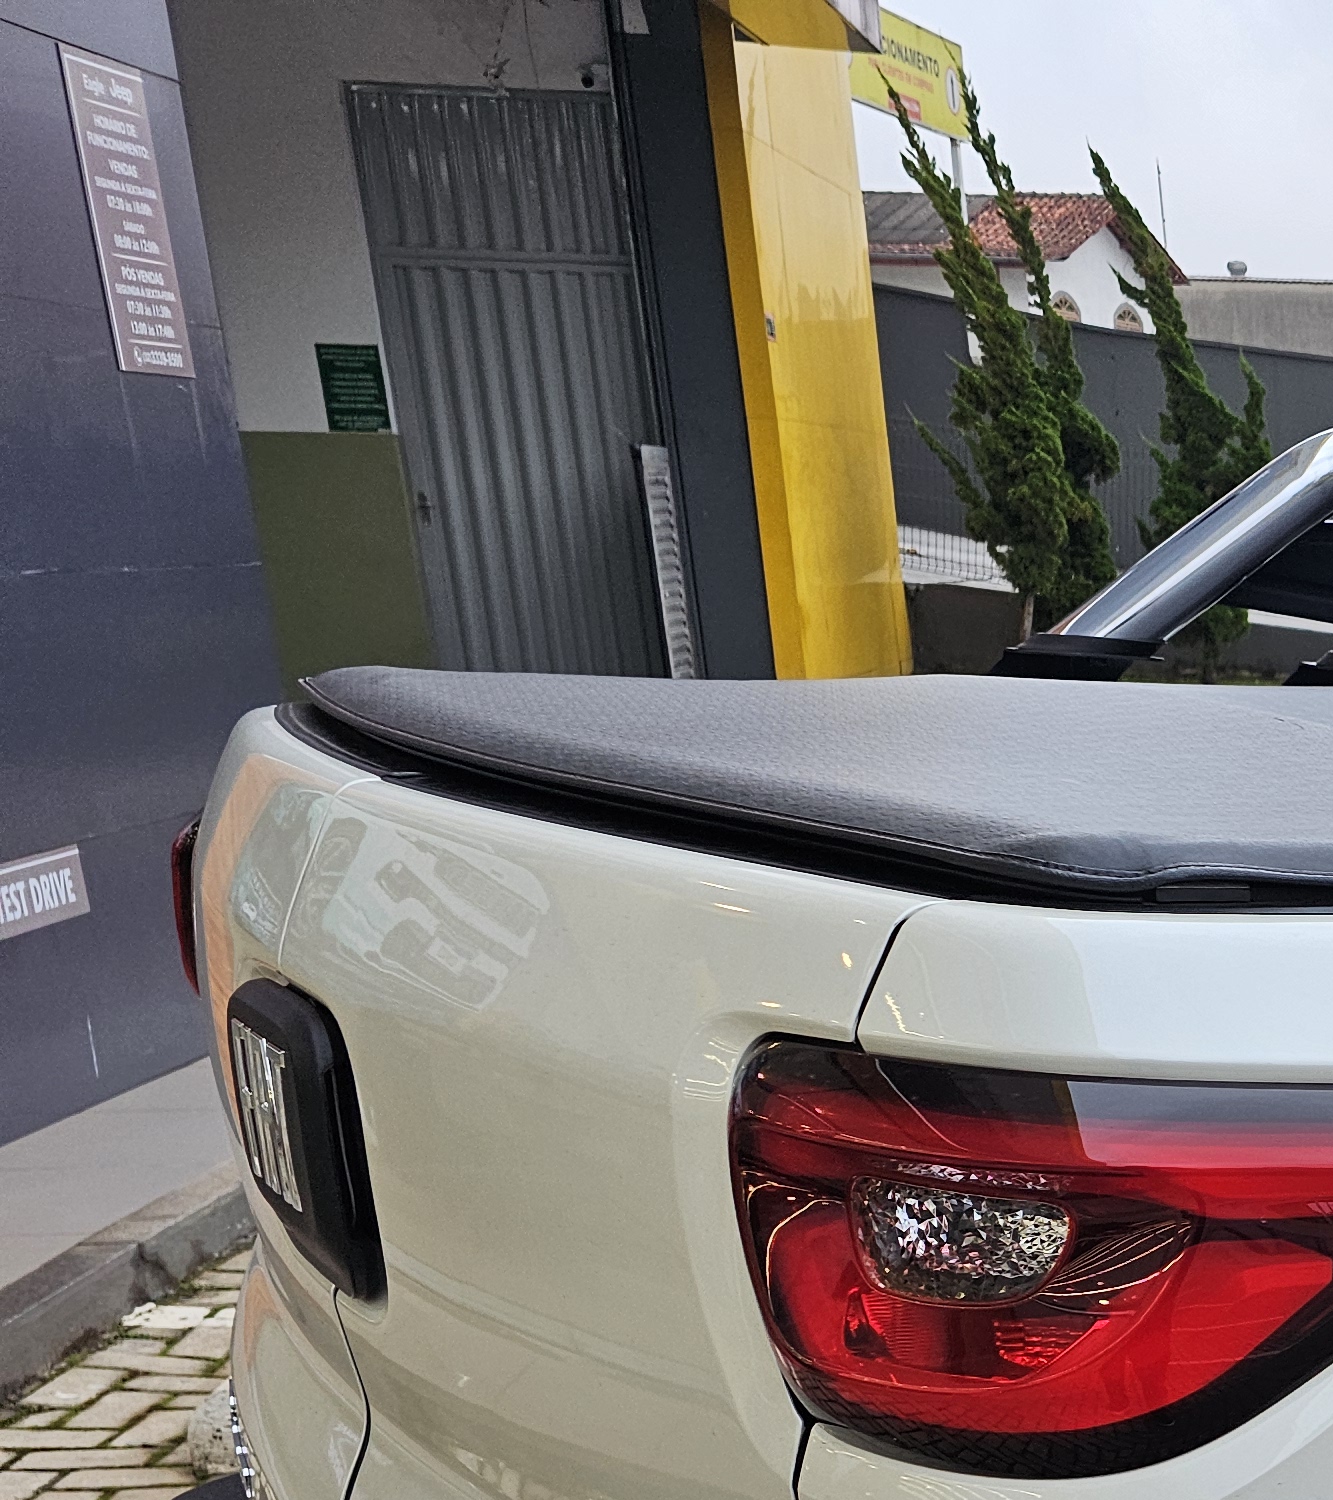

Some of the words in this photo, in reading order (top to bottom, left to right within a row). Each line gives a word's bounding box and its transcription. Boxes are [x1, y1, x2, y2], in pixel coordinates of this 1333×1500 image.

[109, 78, 133, 106] Jeep
[108, 159, 138, 178] VENDAS
[136, 269, 164, 286] VENDAS
[0, 880, 28, 924] EST
[28, 867, 77, 914] DRIVE
